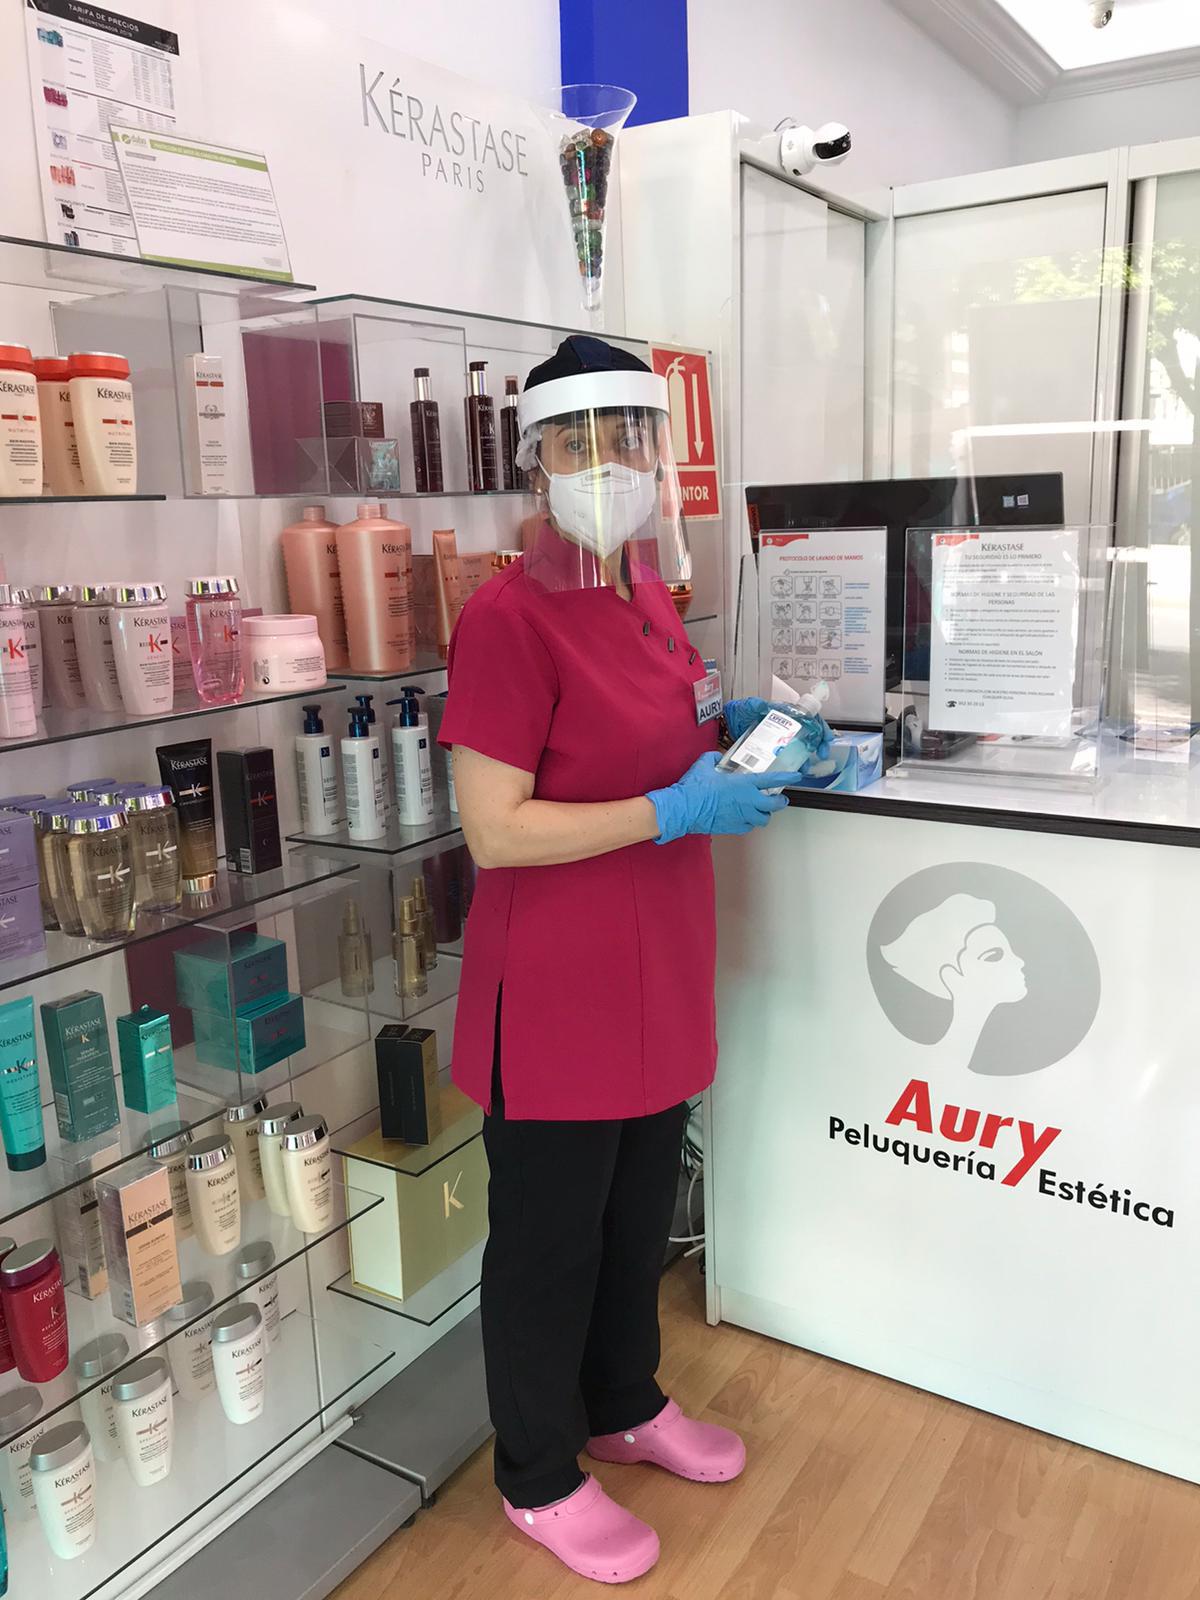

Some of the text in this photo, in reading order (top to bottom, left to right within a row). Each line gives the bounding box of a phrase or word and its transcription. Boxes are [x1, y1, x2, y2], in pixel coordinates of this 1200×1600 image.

[68, 4, 139, 32] TARIFA DE PRECIOS
[359, 63, 528, 176] KÉRASTASE
[422, 153, 484, 193] PARIS
[682, 485, 709, 501] NTOR
[700, 699, 721, 720] AURY
[885, 1079, 1062, 1187] Aury
[829, 1116, 1175, 1228] Peluquería Estética
[443, 1170, 464, 1219] K
[54, 1461, 91, 1489] KÉRASTASE
